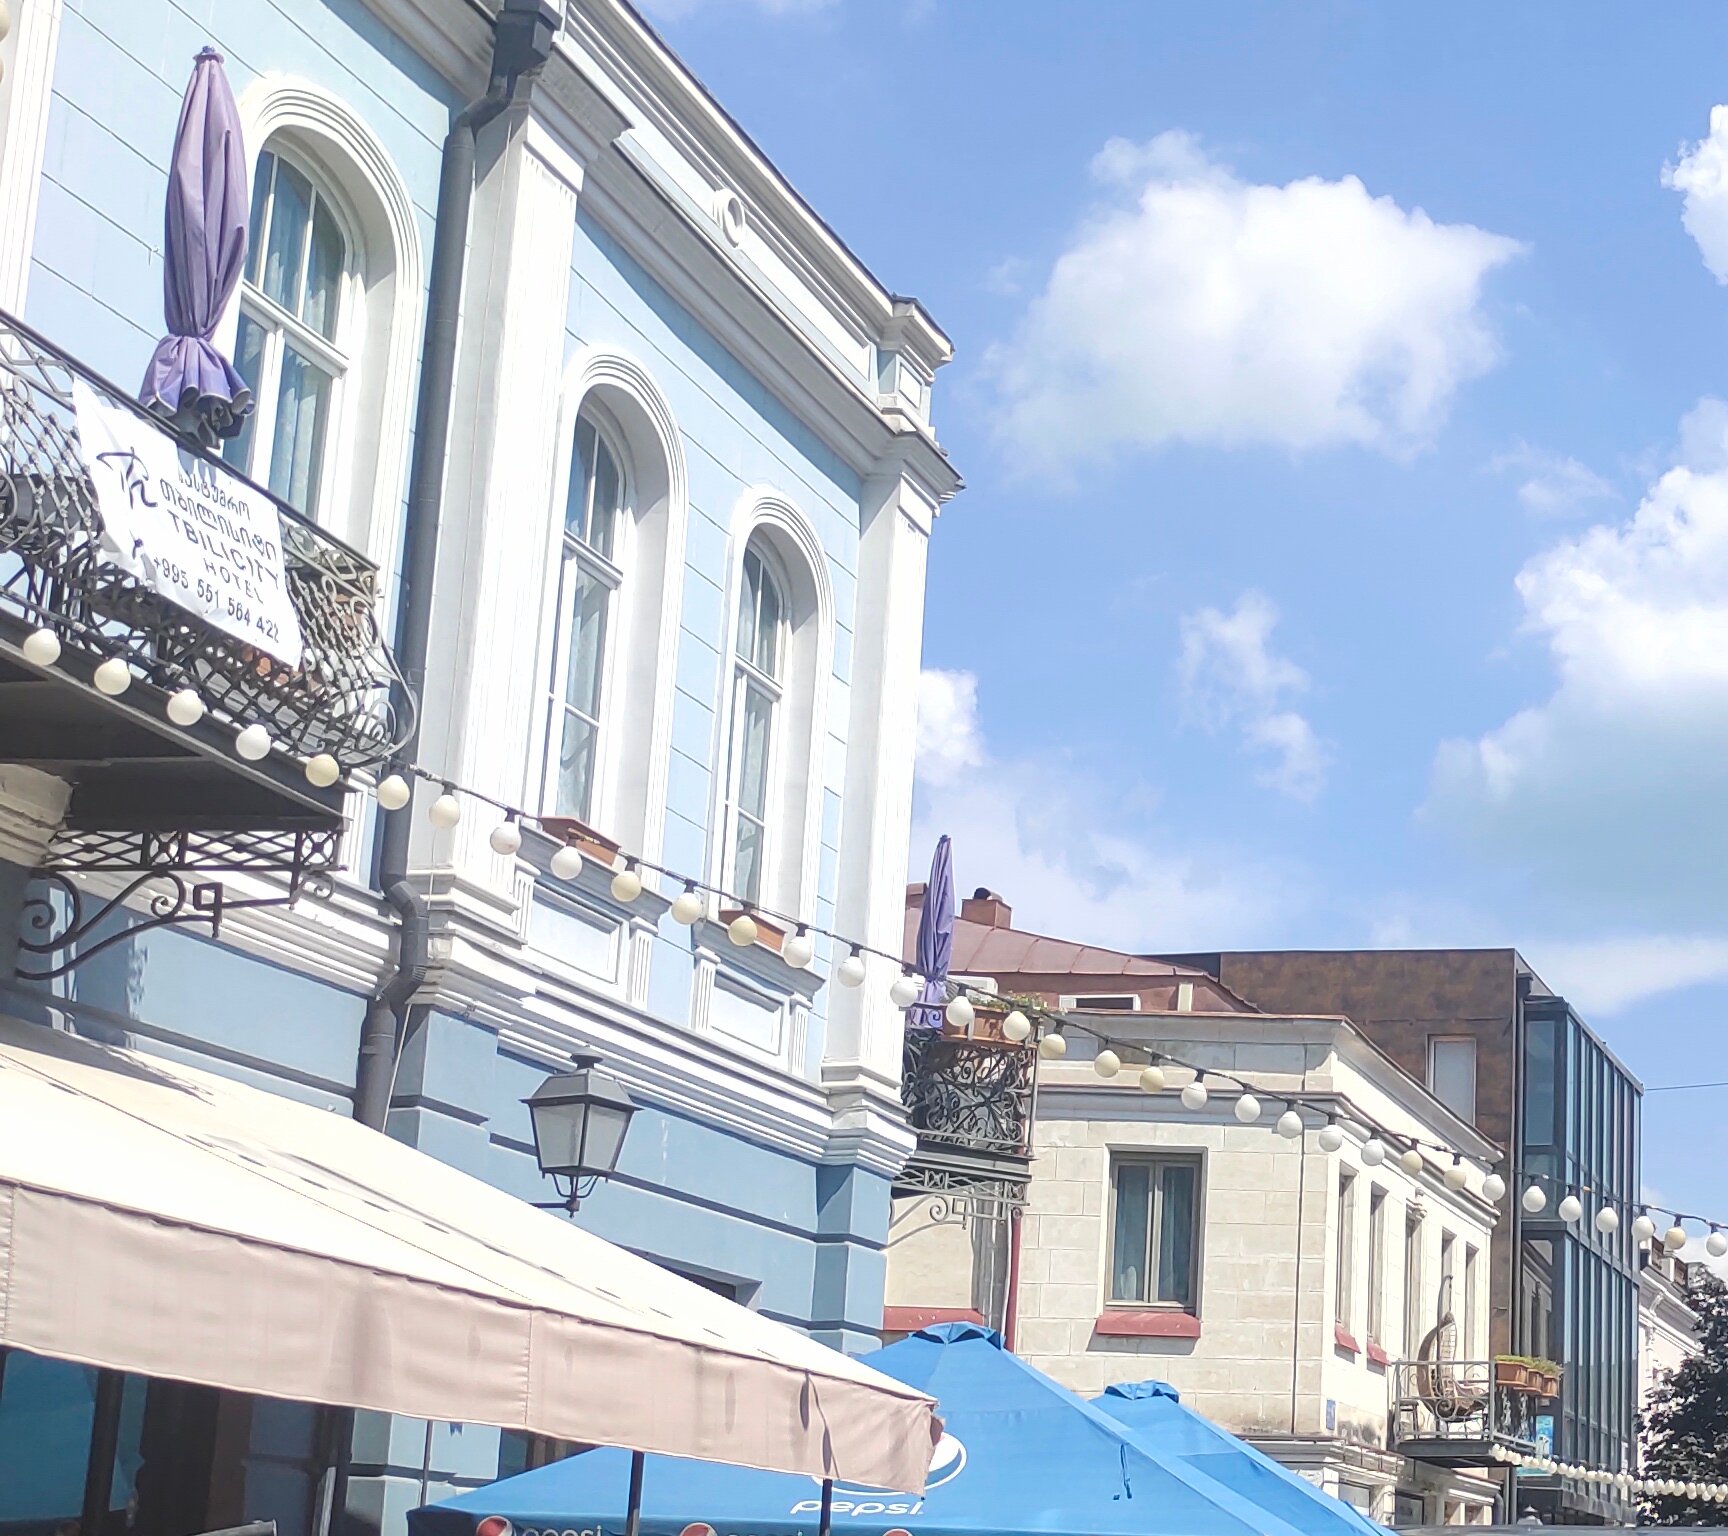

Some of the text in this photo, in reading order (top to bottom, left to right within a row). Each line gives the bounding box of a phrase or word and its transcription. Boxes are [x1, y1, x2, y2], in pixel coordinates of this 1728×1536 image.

[167, 509, 279, 591] TBILICITY
[154, 557, 189, 590] +995
[197, 578, 220, 609] 551
[227, 597, 251, 627] 564
[203, 557, 264, 605] HOTEL
[789, 1500, 925, 1516] pepsi
